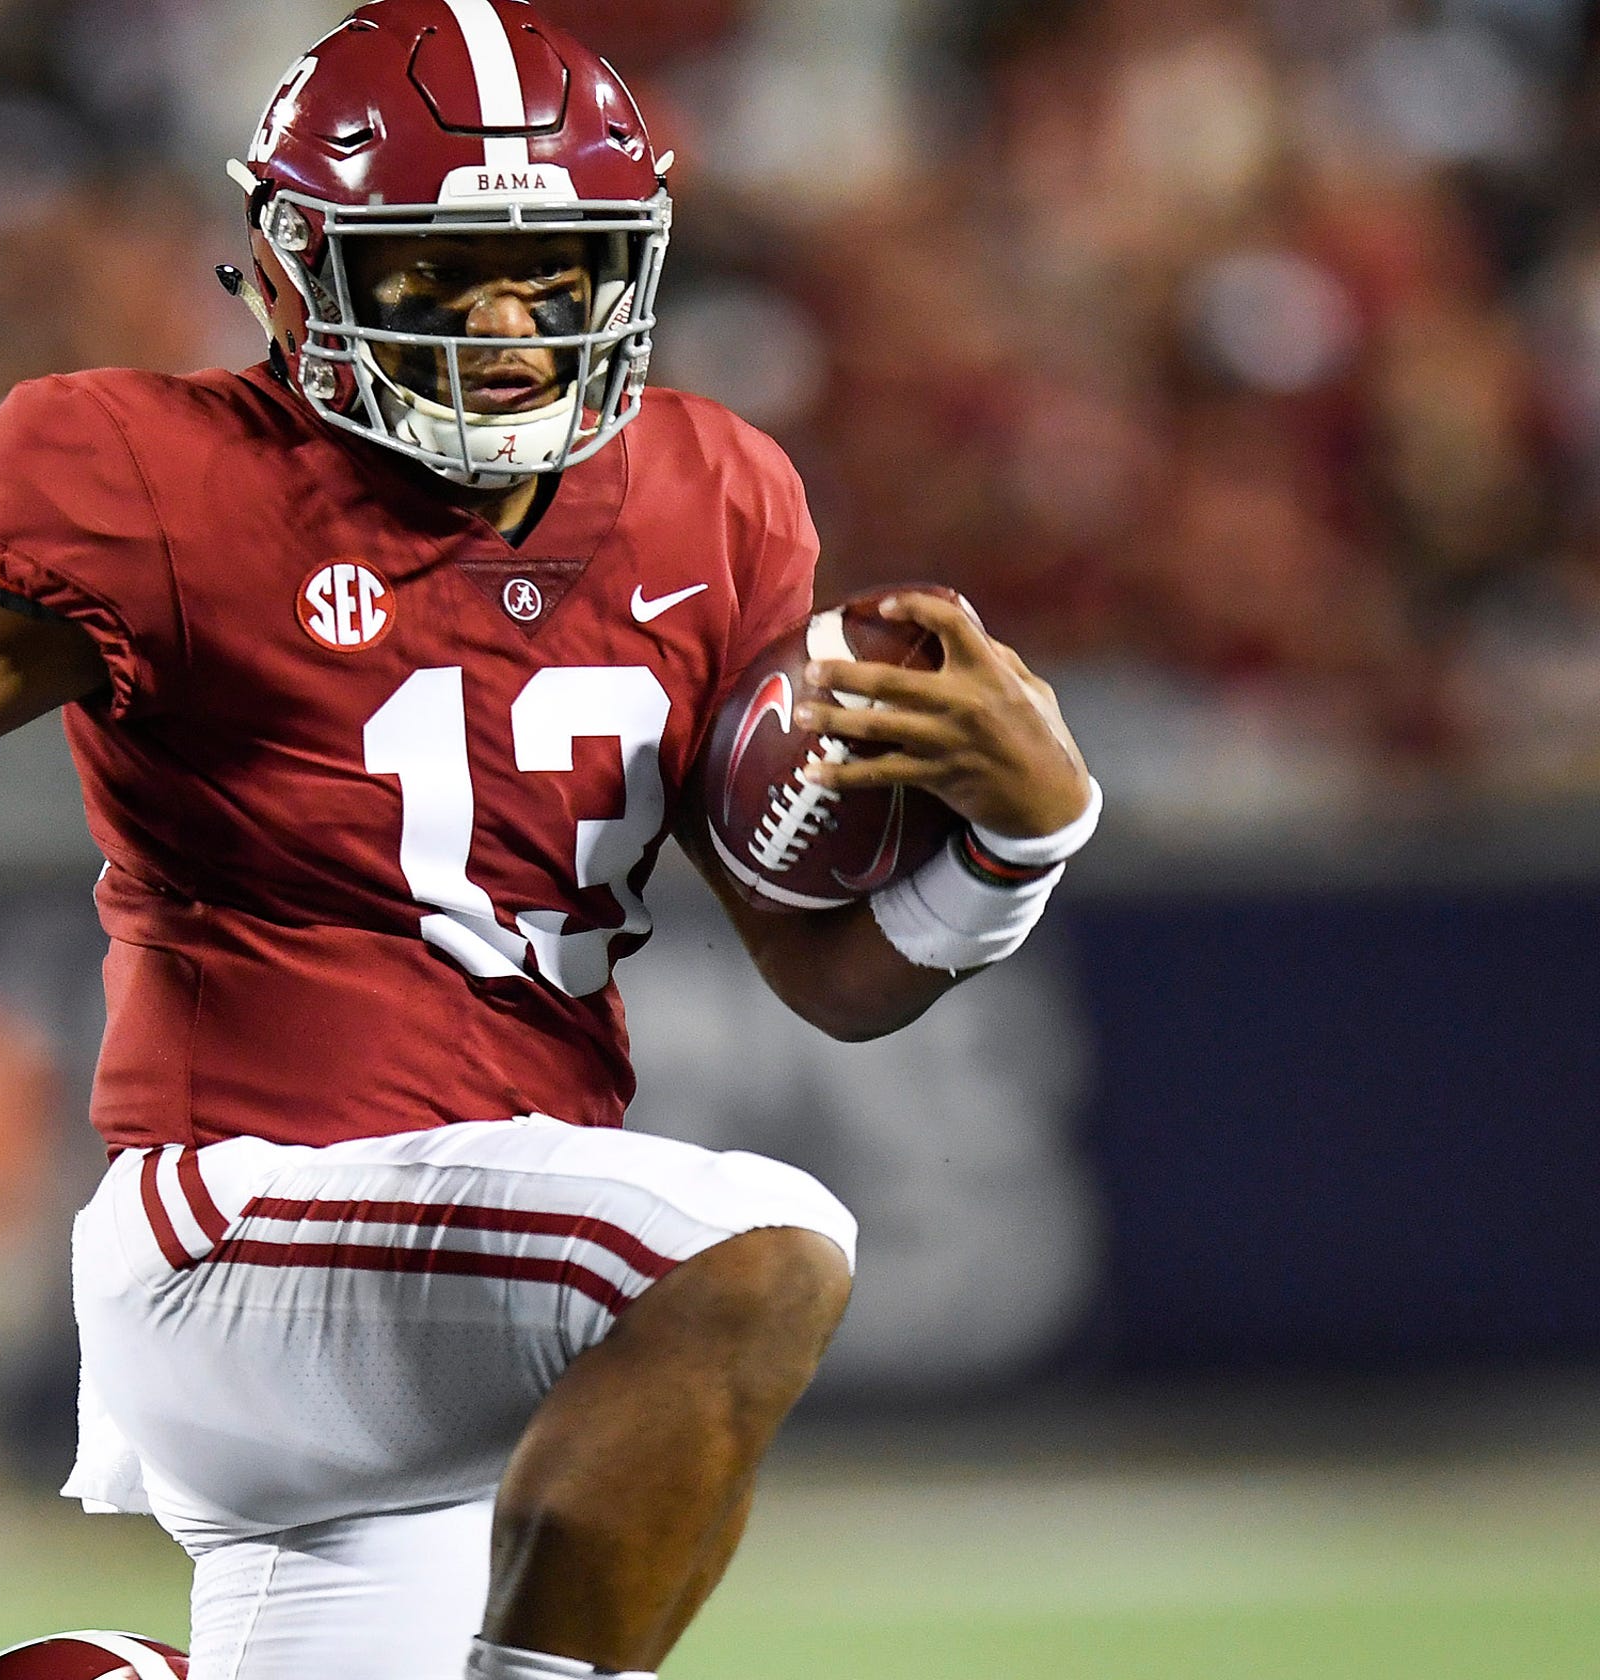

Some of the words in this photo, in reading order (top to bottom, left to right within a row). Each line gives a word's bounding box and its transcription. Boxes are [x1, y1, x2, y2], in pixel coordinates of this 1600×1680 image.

[477, 173, 547, 191] BAMA
[305, 563, 388, 646] SEC
[511, 584, 536, 613] A
[363, 666, 672, 998] 13
